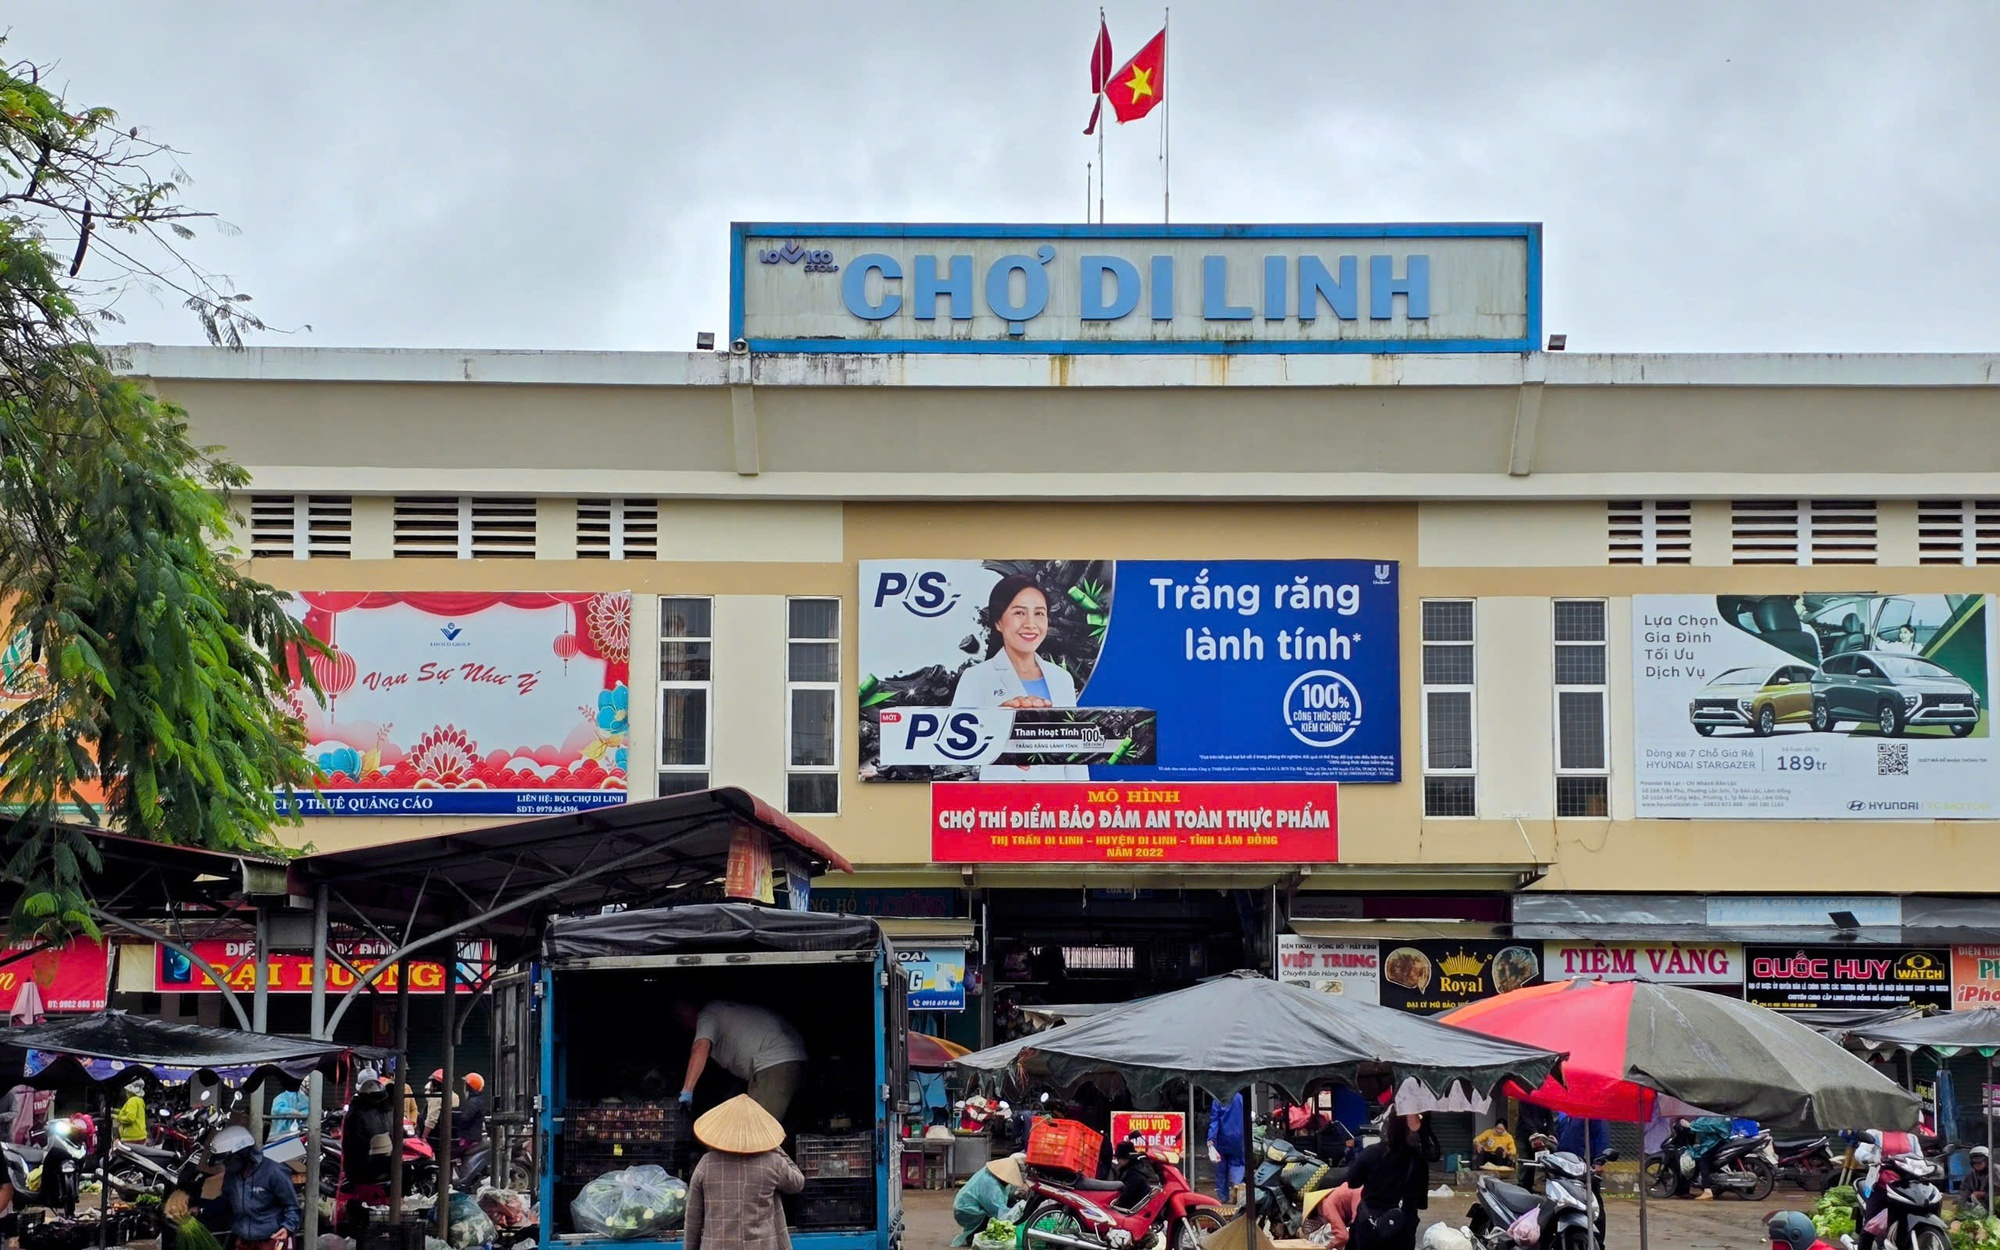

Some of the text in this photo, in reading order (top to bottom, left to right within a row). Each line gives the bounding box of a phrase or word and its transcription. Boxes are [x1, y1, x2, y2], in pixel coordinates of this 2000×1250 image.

[804, 265, 839, 273] GROUP
[841, 245, 1430, 336] CHỢ DI LINH
[1149, 568, 1360, 616] Trắng răng
[1644, 615, 1718, 628] Lựa Chọn
[1185, 626, 1265, 661] lành
[1644, 632, 1711, 643] Gia Đình
[1644, 647, 1694, 660] Tối Ưu
[362, 662, 542, 696] Vạn Sự Như Ý
[1646, 666, 1705, 680] Dịch Vụ
[1301, 683, 1350, 709] 100%
[1015, 728, 1079, 738] Than Hoạt Tính
[1646, 749, 1672, 759] Dòng
[1689, 749, 1695, 757] 7
[1698, 748, 1718, 757] Chỗ
[1720, 748, 1738, 757] Giá
[1741, 748, 1754, 757] Rẻ
[1646, 761, 1756, 769] HYUNDAI STARGAZER
[517, 793, 537, 802] LIÊN
[554, 795, 572, 803] BQL
[572, 795, 591, 804] CHỢ
[603, 795, 624, 803] LINH
[1087, 788, 1180, 803] MÔ HÌNH
[349, 795, 399, 811] QUẢNG
[402, 795, 433, 809] CÁO
[1869, 801, 1919, 810] HYUNDAI
[939, 801, 1330, 832] CHỢ THÍ ĐIỂM BẢO ĐẢM AN TOÀN THỰC PHẨM
[991, 835, 1008, 846] THỊ
[1012, 834, 1041, 845] TRẤN
[1045, 836, 1055, 845] DI
[1059, 836, 1083, 845] LINH
[1096, 835, 1135, 846] HUYỆN
[1138, 836, 1149, 845] DI
[1153, 836, 1177, 845] LINH
[1190, 834, 1214, 845] TỈNH
[1218, 834, 1242, 845] LÂM
[1247, 833, 1278, 845] ĐỒNG
[1107, 848, 1163, 857] NĂM 2022
[1958, 946, 1980, 957] ĐIỆN
[1281, 951, 1377, 969] VIỆT TRUNG
[1560, 941, 1730, 982] TIỆM VÀNG
[1753, 950, 1891, 979] QUỐC HUY
[1898, 969, 1942, 979] WATCH
[1440, 976, 1483, 995] Royal
[1129, 1119, 1149, 1130] KHU
